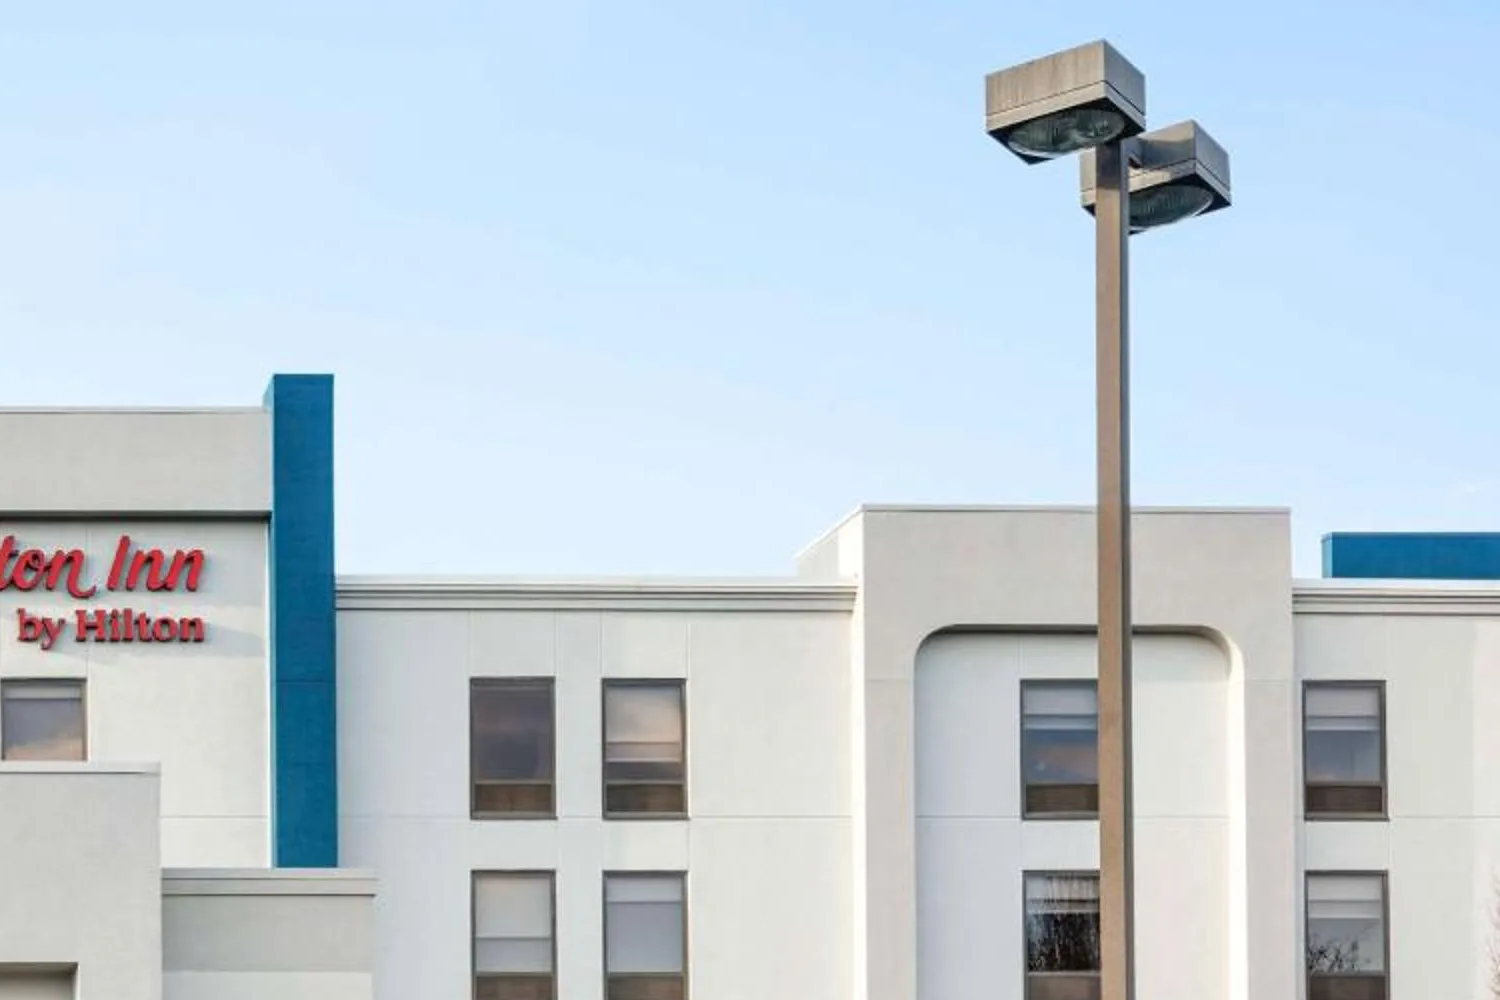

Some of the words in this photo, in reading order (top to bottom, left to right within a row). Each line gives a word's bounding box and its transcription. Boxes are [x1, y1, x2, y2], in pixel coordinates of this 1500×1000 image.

[105, 535, 206, 592] Inn
[17, 608, 65, 650] by
[74, 608, 206, 643] Hilton
